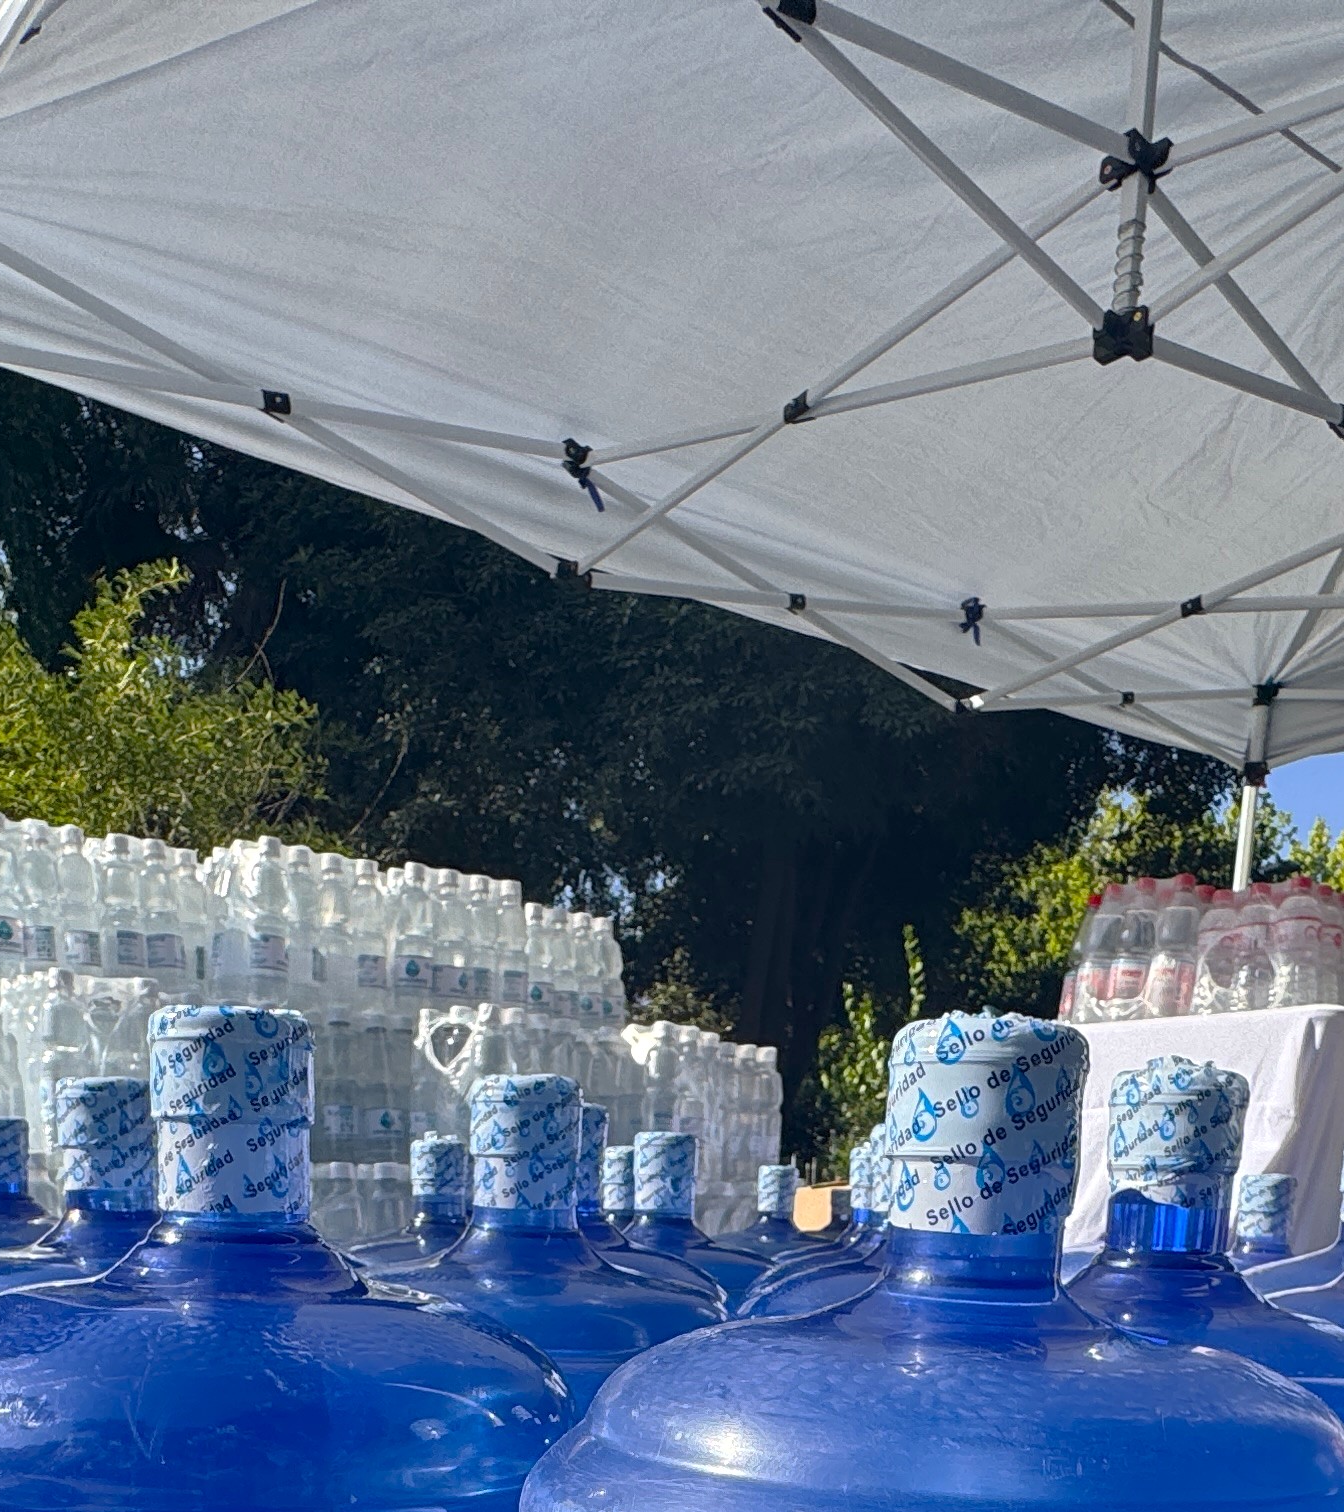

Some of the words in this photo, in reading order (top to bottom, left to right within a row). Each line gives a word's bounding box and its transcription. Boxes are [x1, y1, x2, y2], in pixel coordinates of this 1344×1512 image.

[167, 1019, 236, 1070] Seguridad
[937, 1029, 985, 1062] Sello
[992, 1019, 1014, 1034] de
[169, 1064, 237, 1115] Seguridad
[932, 1086, 980, 1119] Sello
[987, 1068, 1011, 1089] de
[174, 1110, 240, 1155] Seguridad
[930, 1142, 977, 1171] Sello
[983, 1126, 1007, 1147] de
[1163, 1135, 1191, 1157] Sello
[501, 1180, 530, 1199] Sello
[926, 1195, 974, 1226] Sello
[979, 1182, 1003, 1201] de
